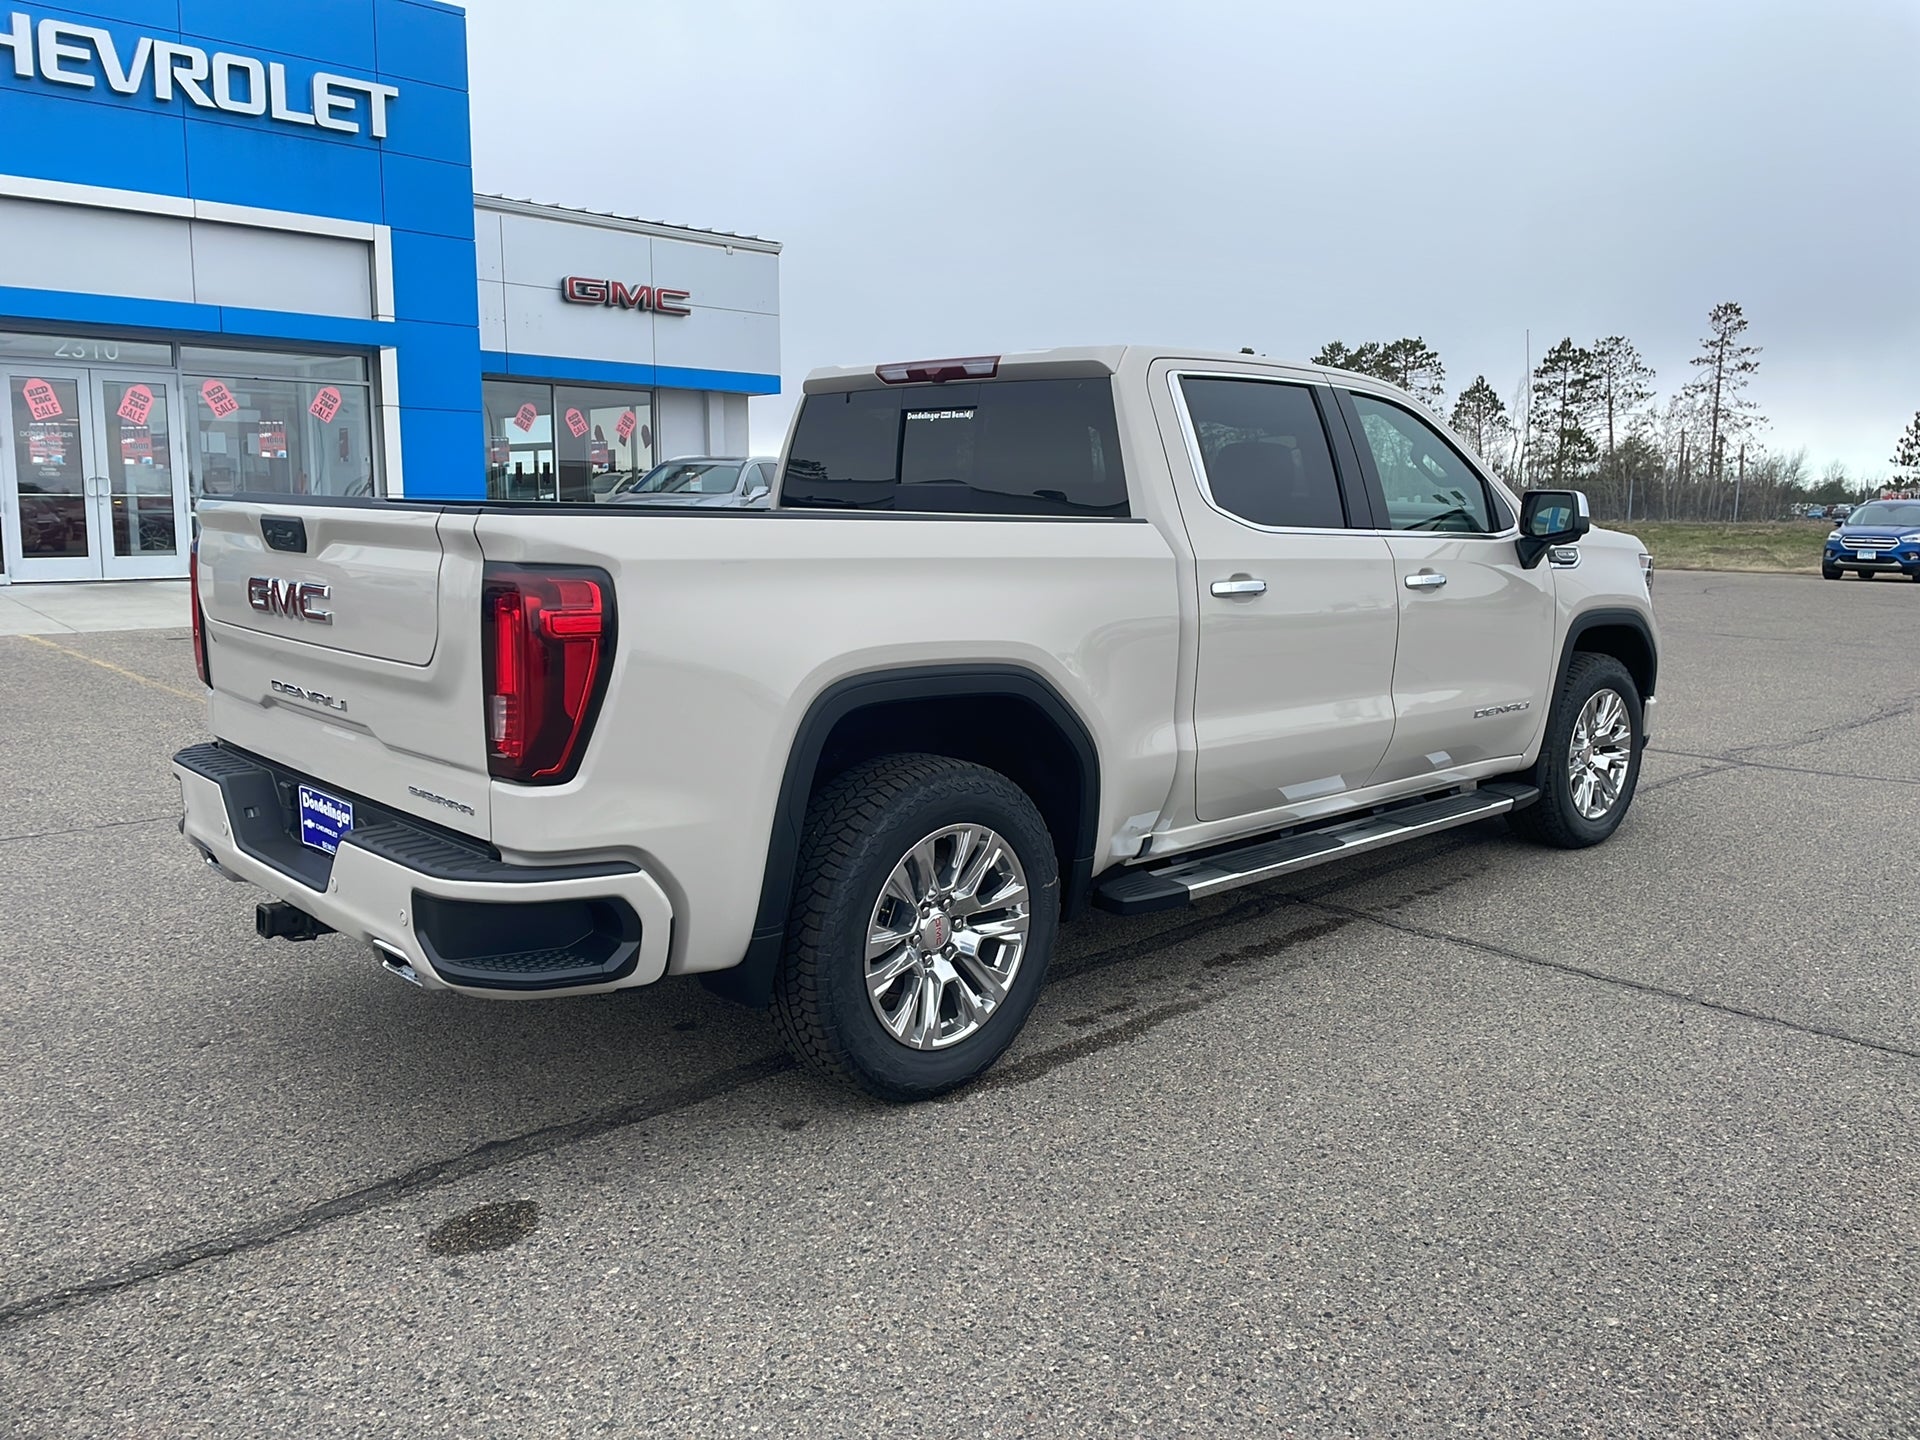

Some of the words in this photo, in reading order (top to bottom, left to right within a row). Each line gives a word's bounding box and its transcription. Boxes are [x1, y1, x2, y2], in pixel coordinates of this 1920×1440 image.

[561, 275, 691, 316] GMC
[27, 385, 48, 397] RED
[130, 390, 150, 403] RED
[205, 385, 224, 398] RED
[210, 392, 228, 404] TAG
[321, 391, 338, 404] RED
[31, 394, 52, 405] TAG
[128, 398, 146, 411] TAG
[214, 398, 237, 416] SALE
[319, 398, 334, 411] TAG
[34, 402, 60, 418] SALE
[120, 405, 145, 423] SALE
[311, 403, 332, 421] SALE
[248, 577, 333, 626] GMC
[270, 679, 347, 712] DENALI
[1473, 701, 1530, 718] DENALI
[408, 785, 475, 816] SIERRA
[302, 791, 350, 828] Dondelinger
